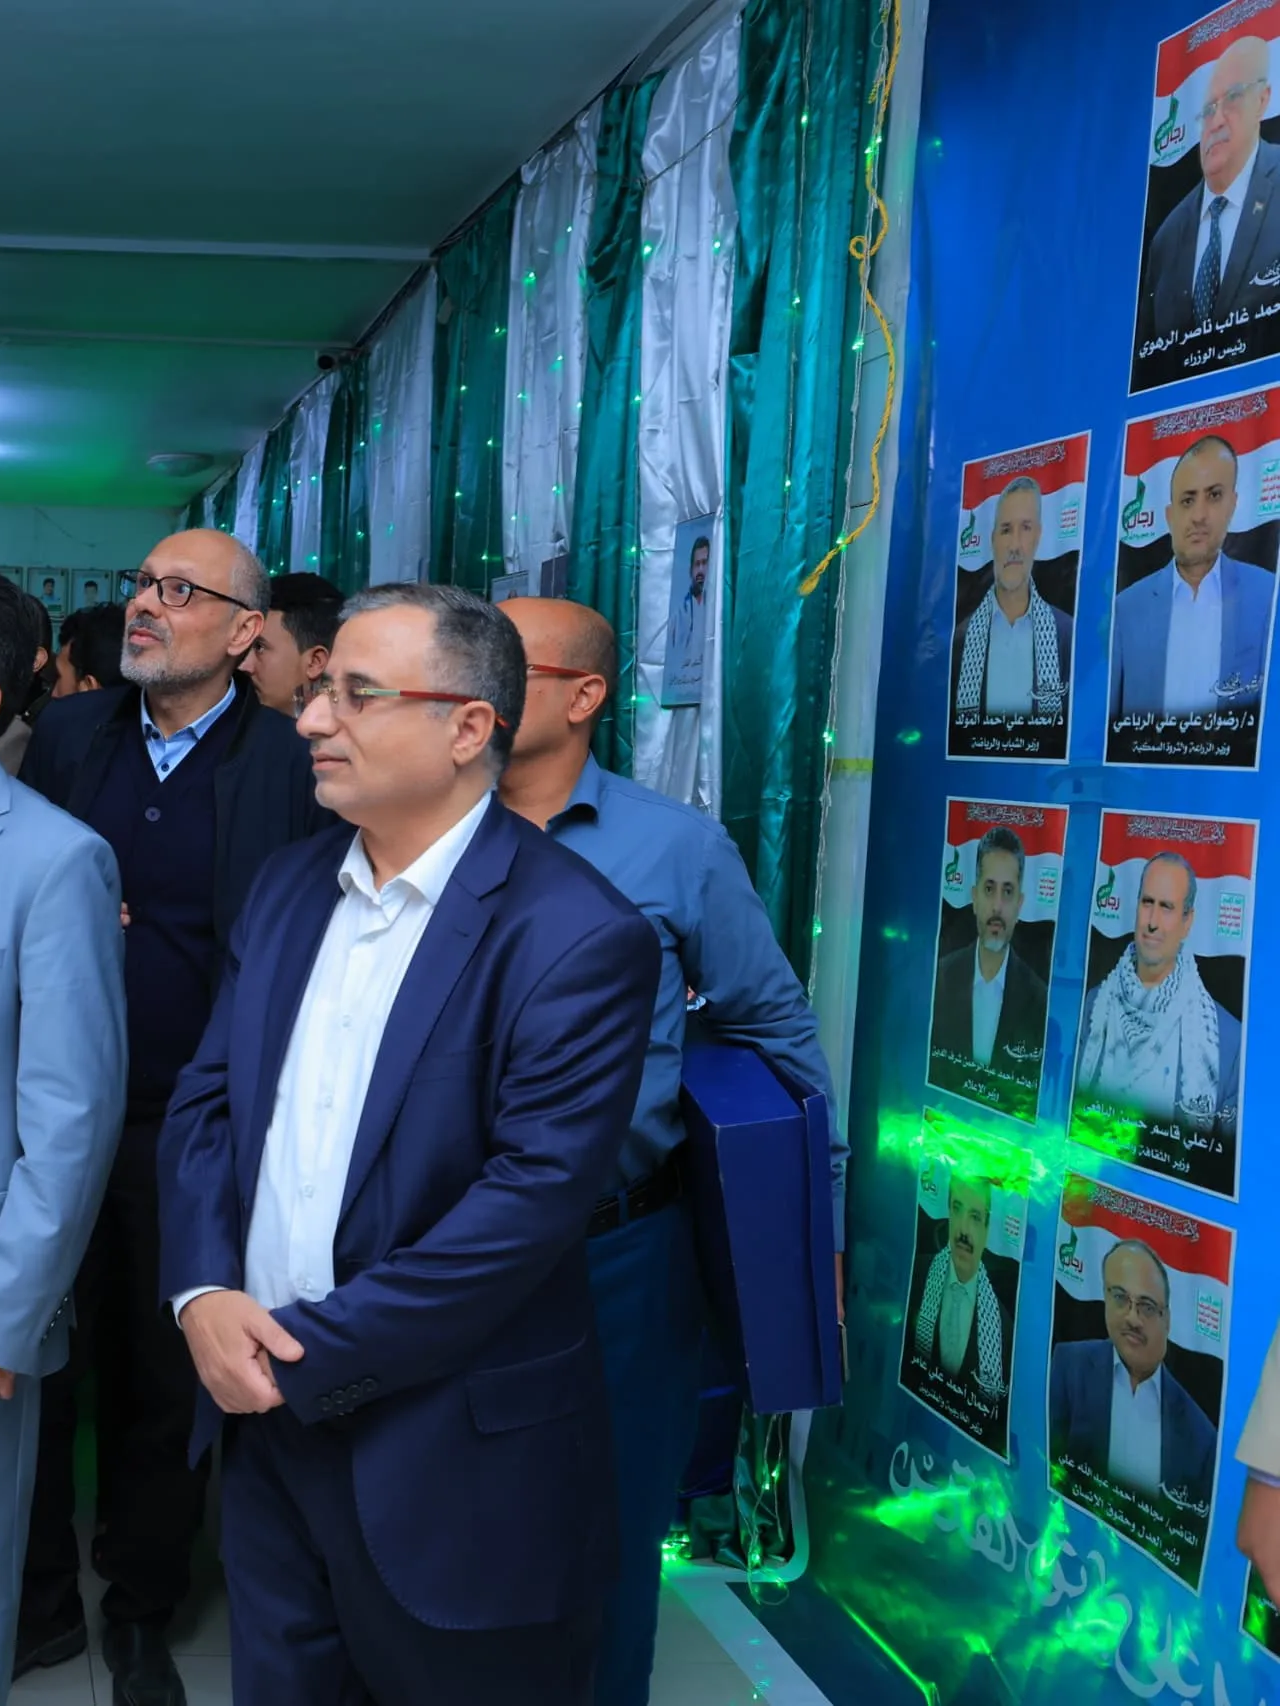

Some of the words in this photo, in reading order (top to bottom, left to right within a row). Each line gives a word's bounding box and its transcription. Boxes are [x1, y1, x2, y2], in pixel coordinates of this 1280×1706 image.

[1216, 308, 1249, 333] غالب
[1180, 318, 1212, 345] ناصر
[1139, 329, 1179, 358] الرهوي
[1218, 338, 1246, 359] رئيس
[1184, 346, 1215, 366] الوزراء
[955, 713, 980, 728] المولد
[1006, 713, 1024, 731] علي
[1113, 711, 1154, 732] الرباعي
[1155, 711, 1176, 732] علي
[1179, 711, 1202, 732] علي
[971, 738, 1000, 750] والرياضة
[1002, 738, 1024, 751] الشباب
[1025, 737, 1040, 751] وزير
[1132, 741, 1166, 753] السمكية
[1189, 742, 1214, 756] الزراعة
[1215, 743, 1230, 756] وزير
[986, 1088, 999, 1102] وزير
[1150, 1124, 1180, 1141] قاسم
[1138, 1145, 1171, 1164] الثقافة
[1172, 1161, 1190, 1173] وزير
[910, 1356, 927, 1371] عامر
[928, 1366, 943, 1382] علي
[946, 1379, 967, 1398] أحمد
[970, 1422, 983, 1435] وزير
[1106, 1503, 1136, 1532] وحقوق
[1138, 1499, 1163, 1522] مجاهد
[1138, 1527, 1162, 1549] العدل
[1162, 1546, 1180, 1566] وزير
